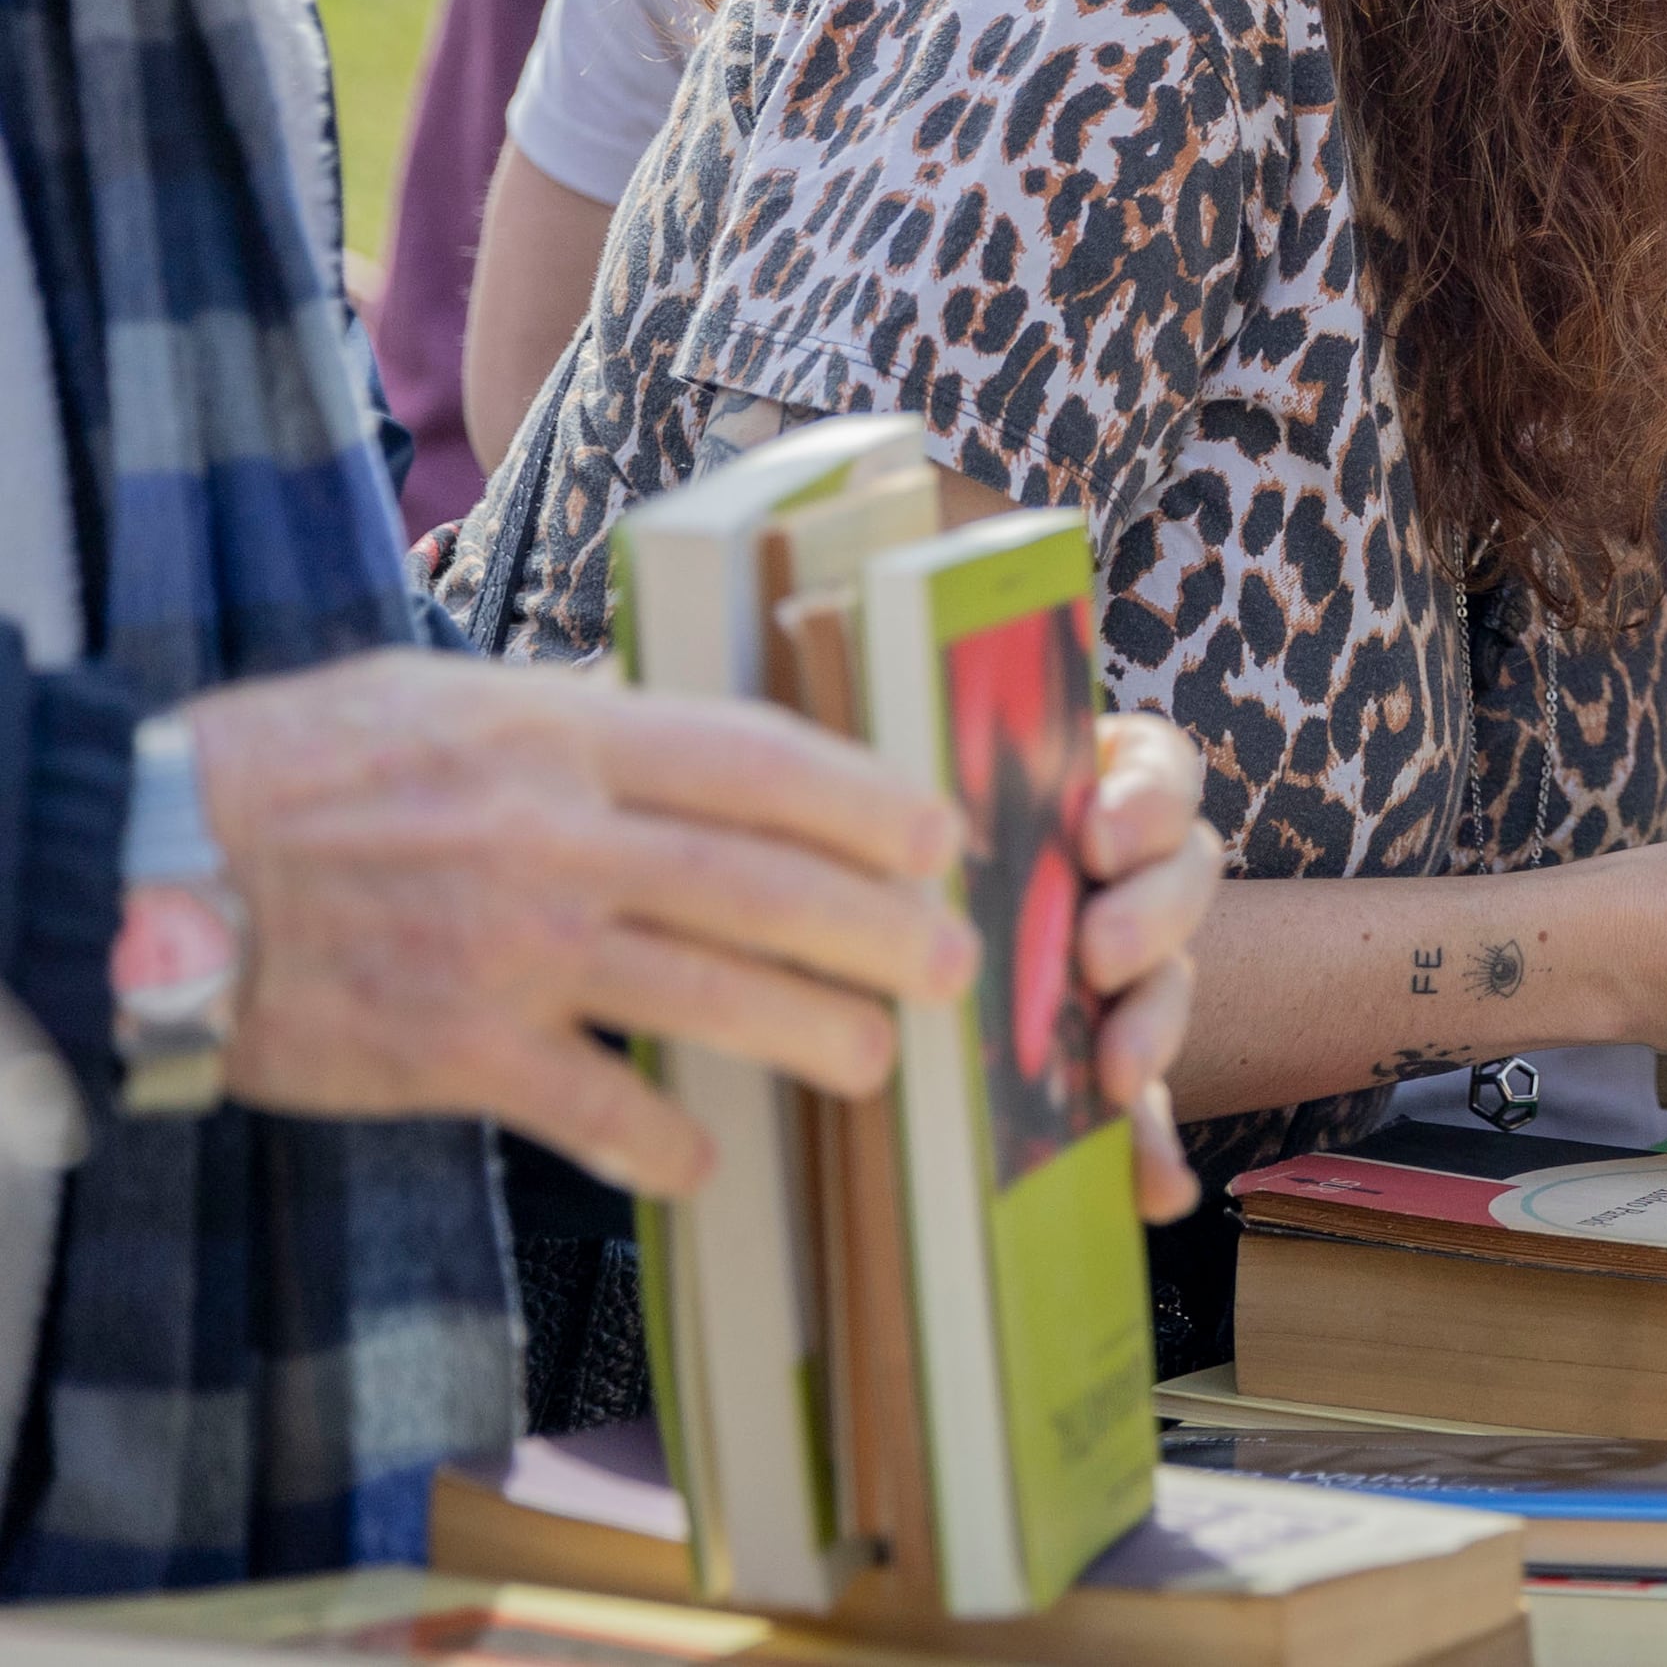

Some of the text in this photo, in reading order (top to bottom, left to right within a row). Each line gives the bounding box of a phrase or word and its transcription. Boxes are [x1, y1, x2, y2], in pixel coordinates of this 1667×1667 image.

[1412, 946, 1441, 994] FE
[1575, 1206, 1648, 1229] Parodi
[1288, 1469, 1442, 1486] Walsh
